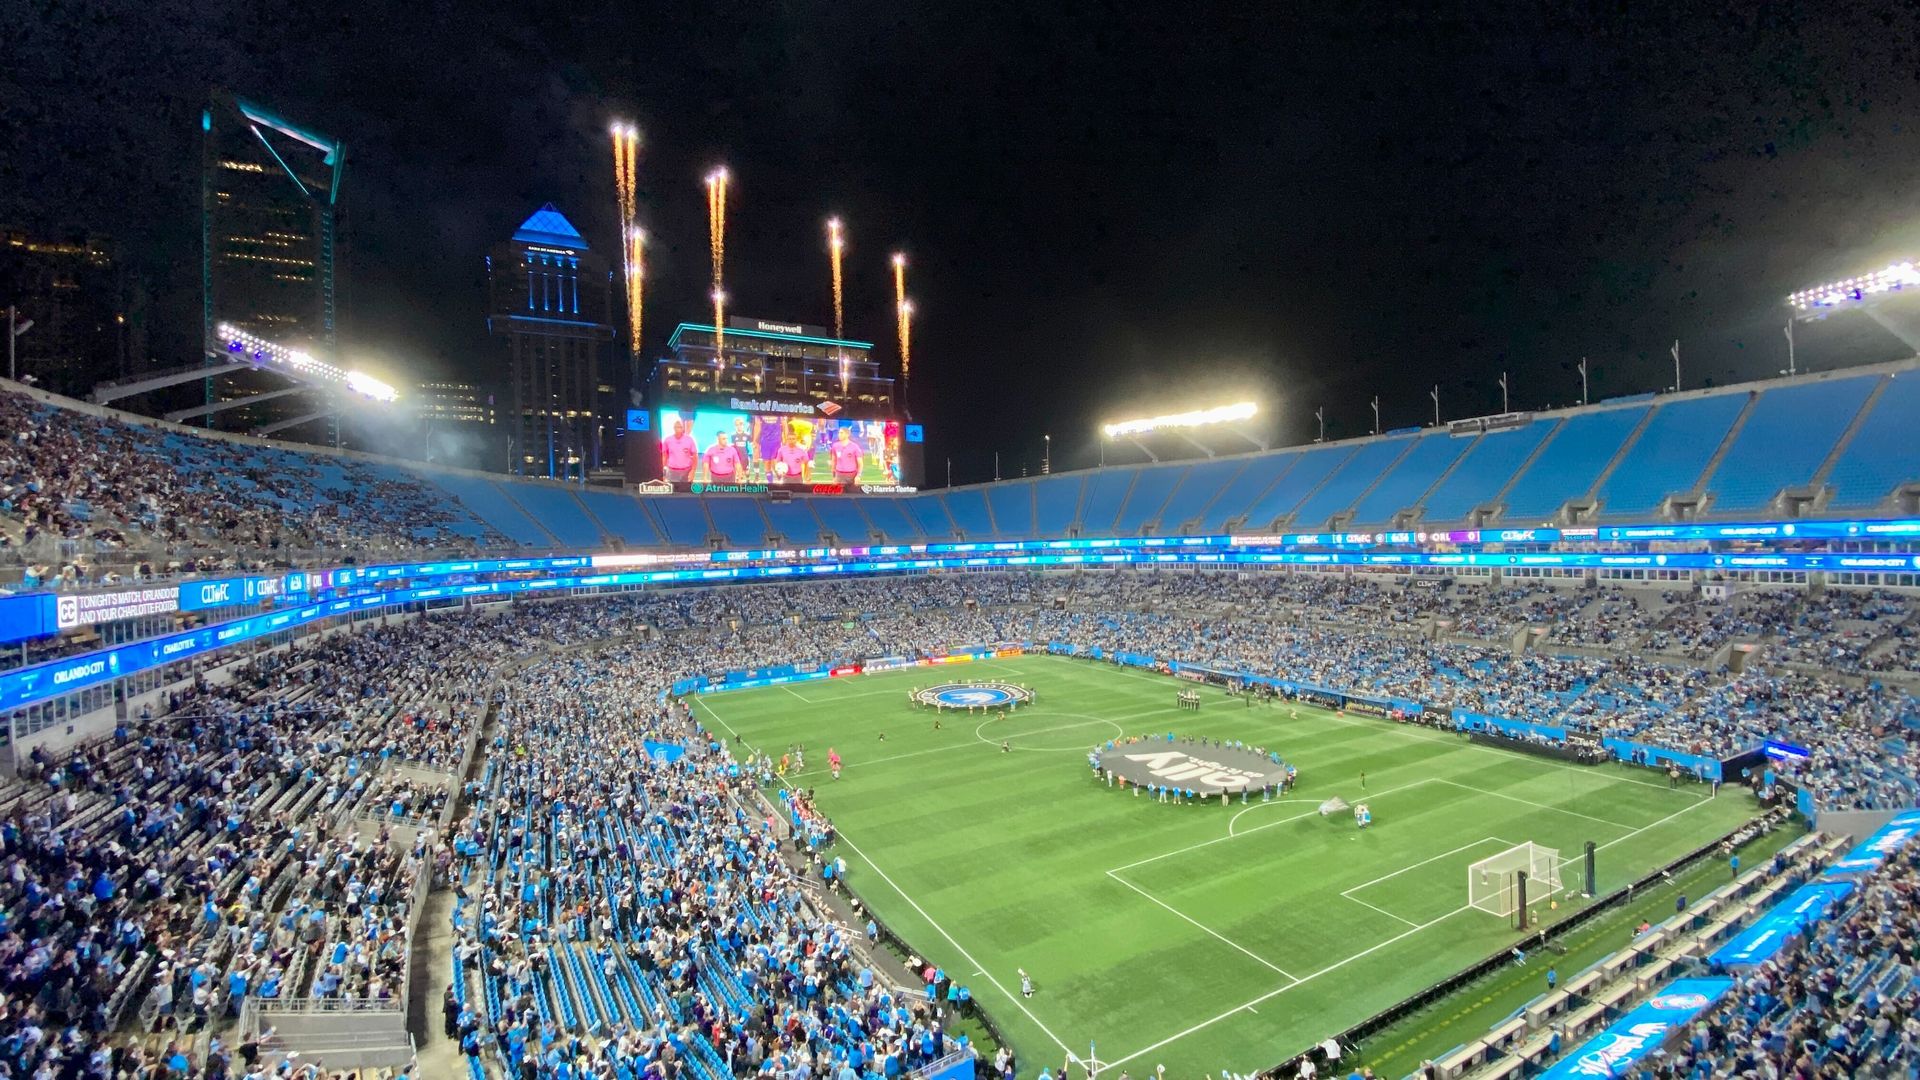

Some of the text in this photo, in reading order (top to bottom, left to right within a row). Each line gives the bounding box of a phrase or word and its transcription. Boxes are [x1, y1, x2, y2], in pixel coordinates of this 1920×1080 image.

[758, 321, 802, 334] Honeywell
[730, 397, 814, 414] Bank of America
[705, 484, 769, 493] Atrium Health
[895, 485, 917, 493] Teeter
[1431, 532, 1451, 542] ORL
[142, 588, 170, 602] ORLANDO
[61, 604, 75, 620] CC
[80, 609, 96, 625] AND
[96, 606, 117, 622] YOUR
[117, 602, 154, 619] CHARLOTTE
[54, 661, 105, 685] ORLANDO CITY
